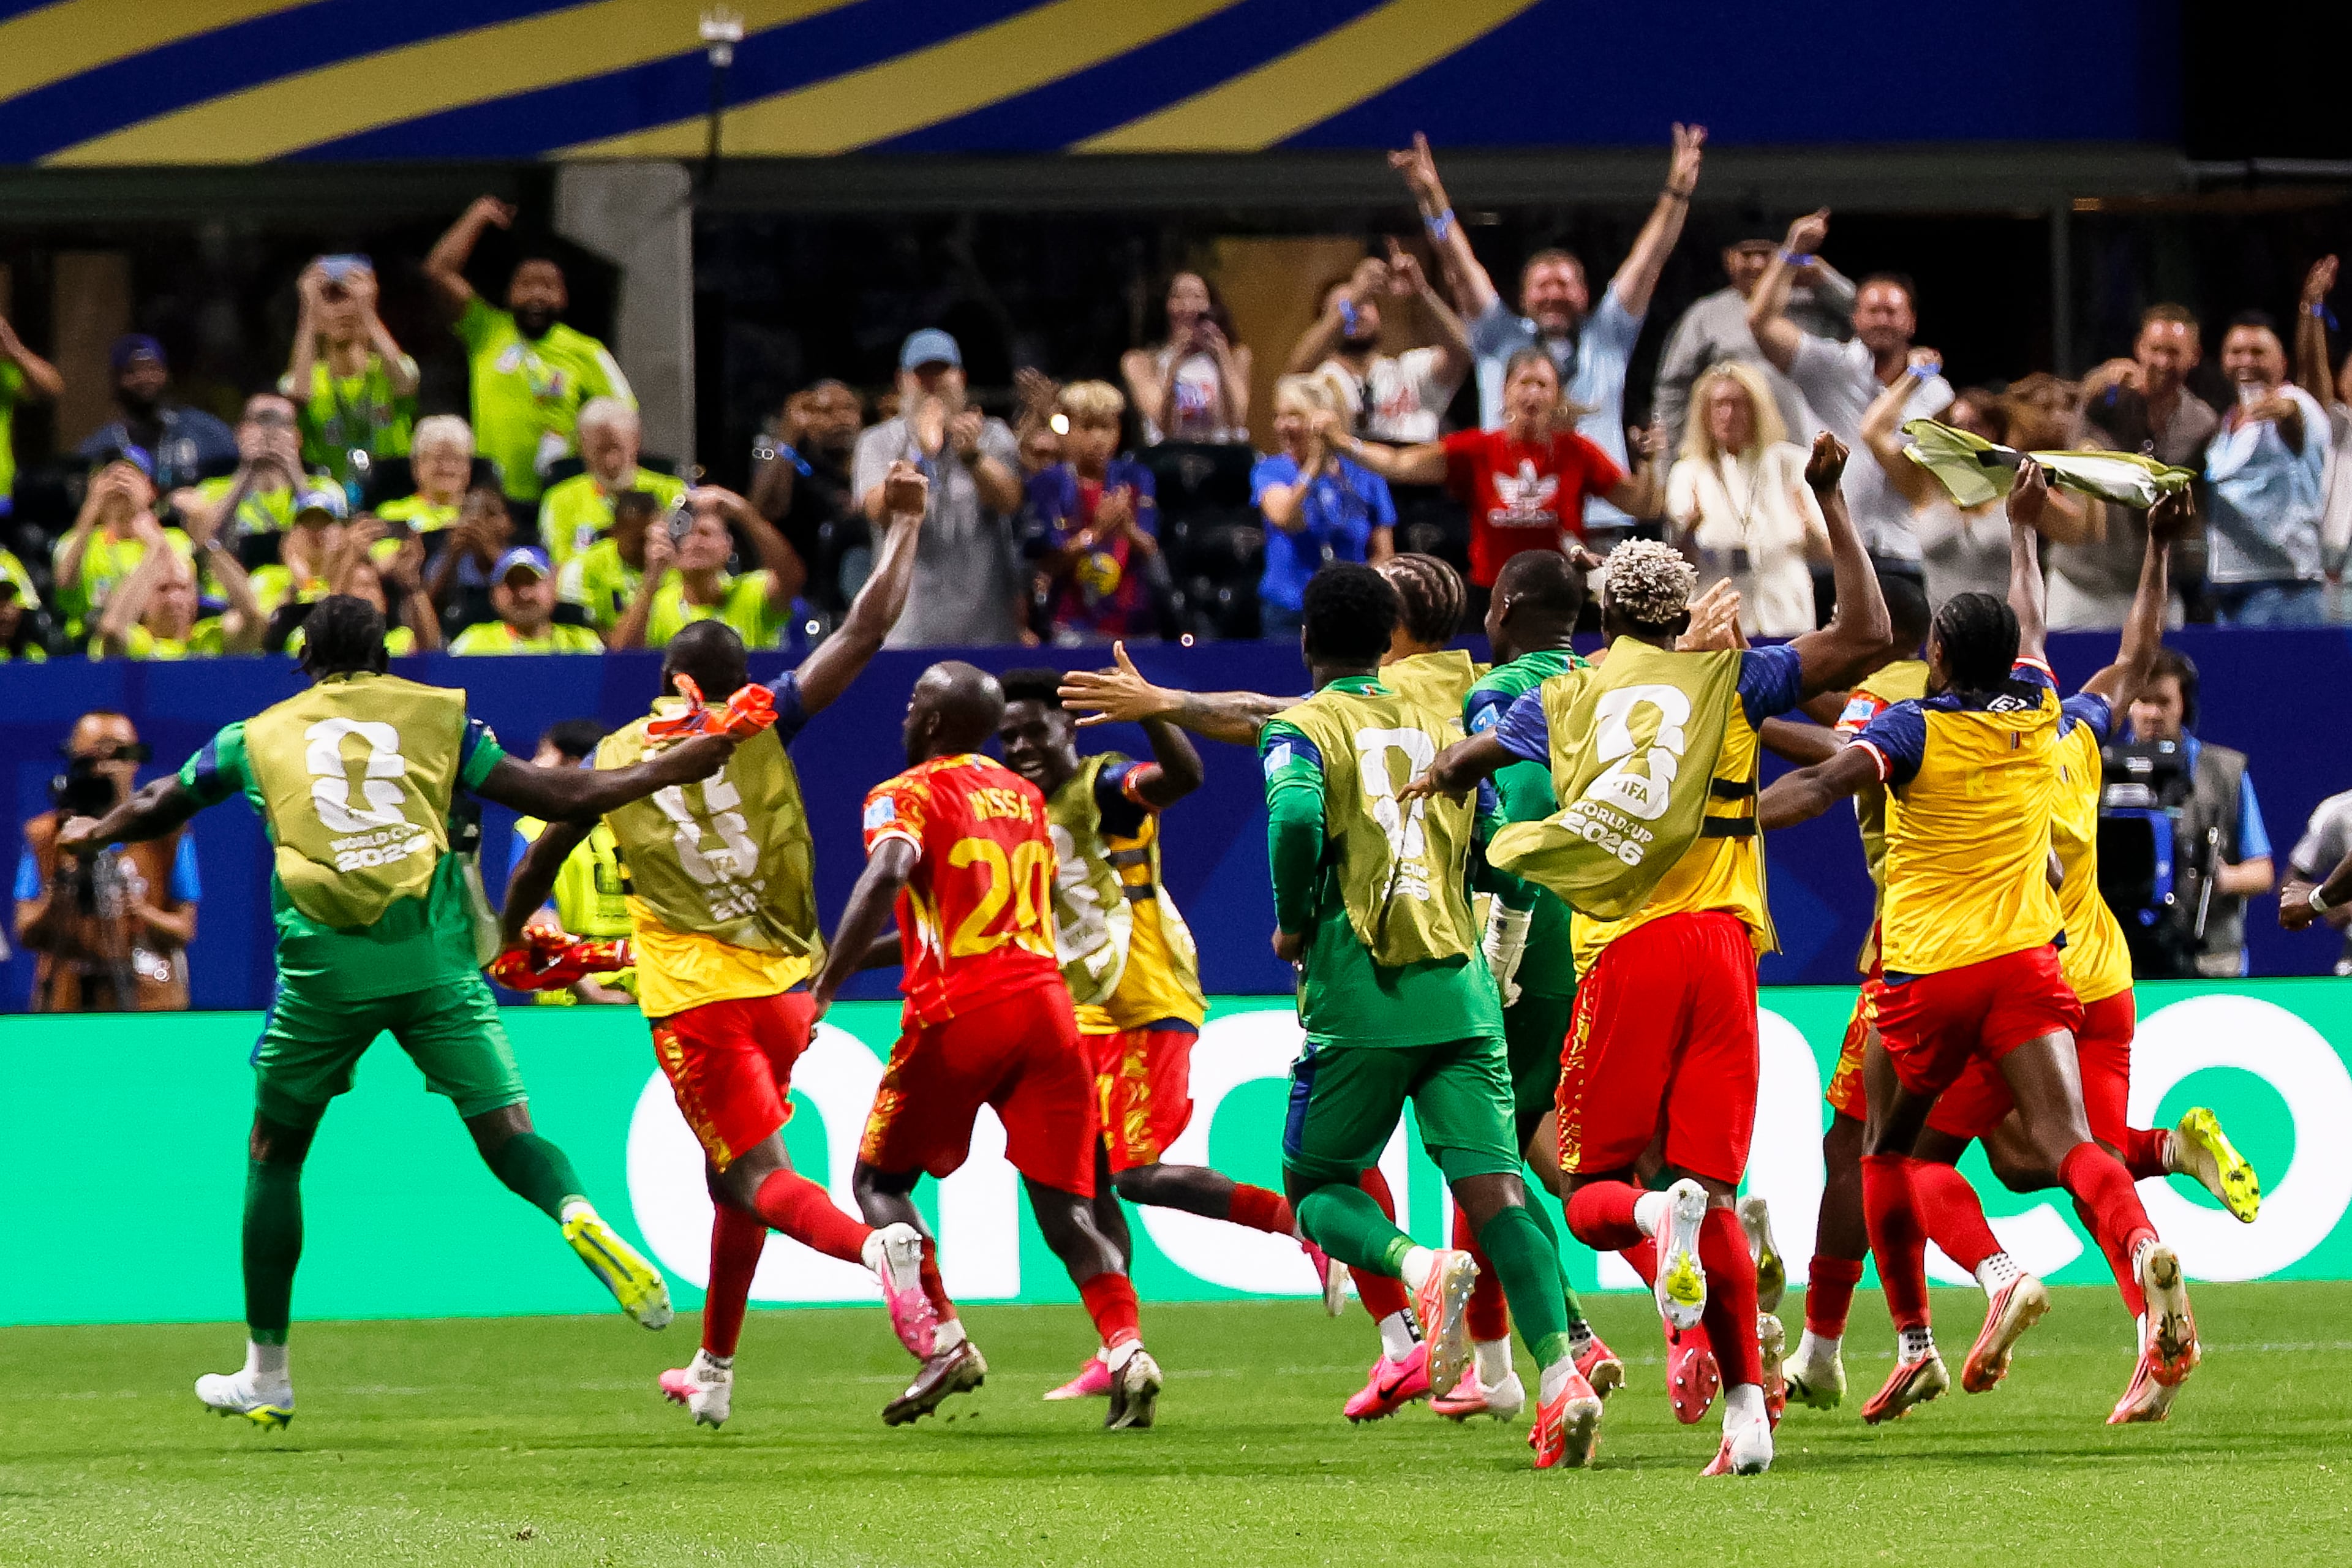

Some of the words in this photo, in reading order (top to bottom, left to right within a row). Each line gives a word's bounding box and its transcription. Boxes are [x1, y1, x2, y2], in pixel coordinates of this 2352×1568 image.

[1613, 781, 1649, 805] IFA
[1559, 812, 1644, 866] 2026
[1623, 822, 1654, 843] CUP
[948, 837, 1055, 959] 20
[626, 994, 2351, 1301] aao
